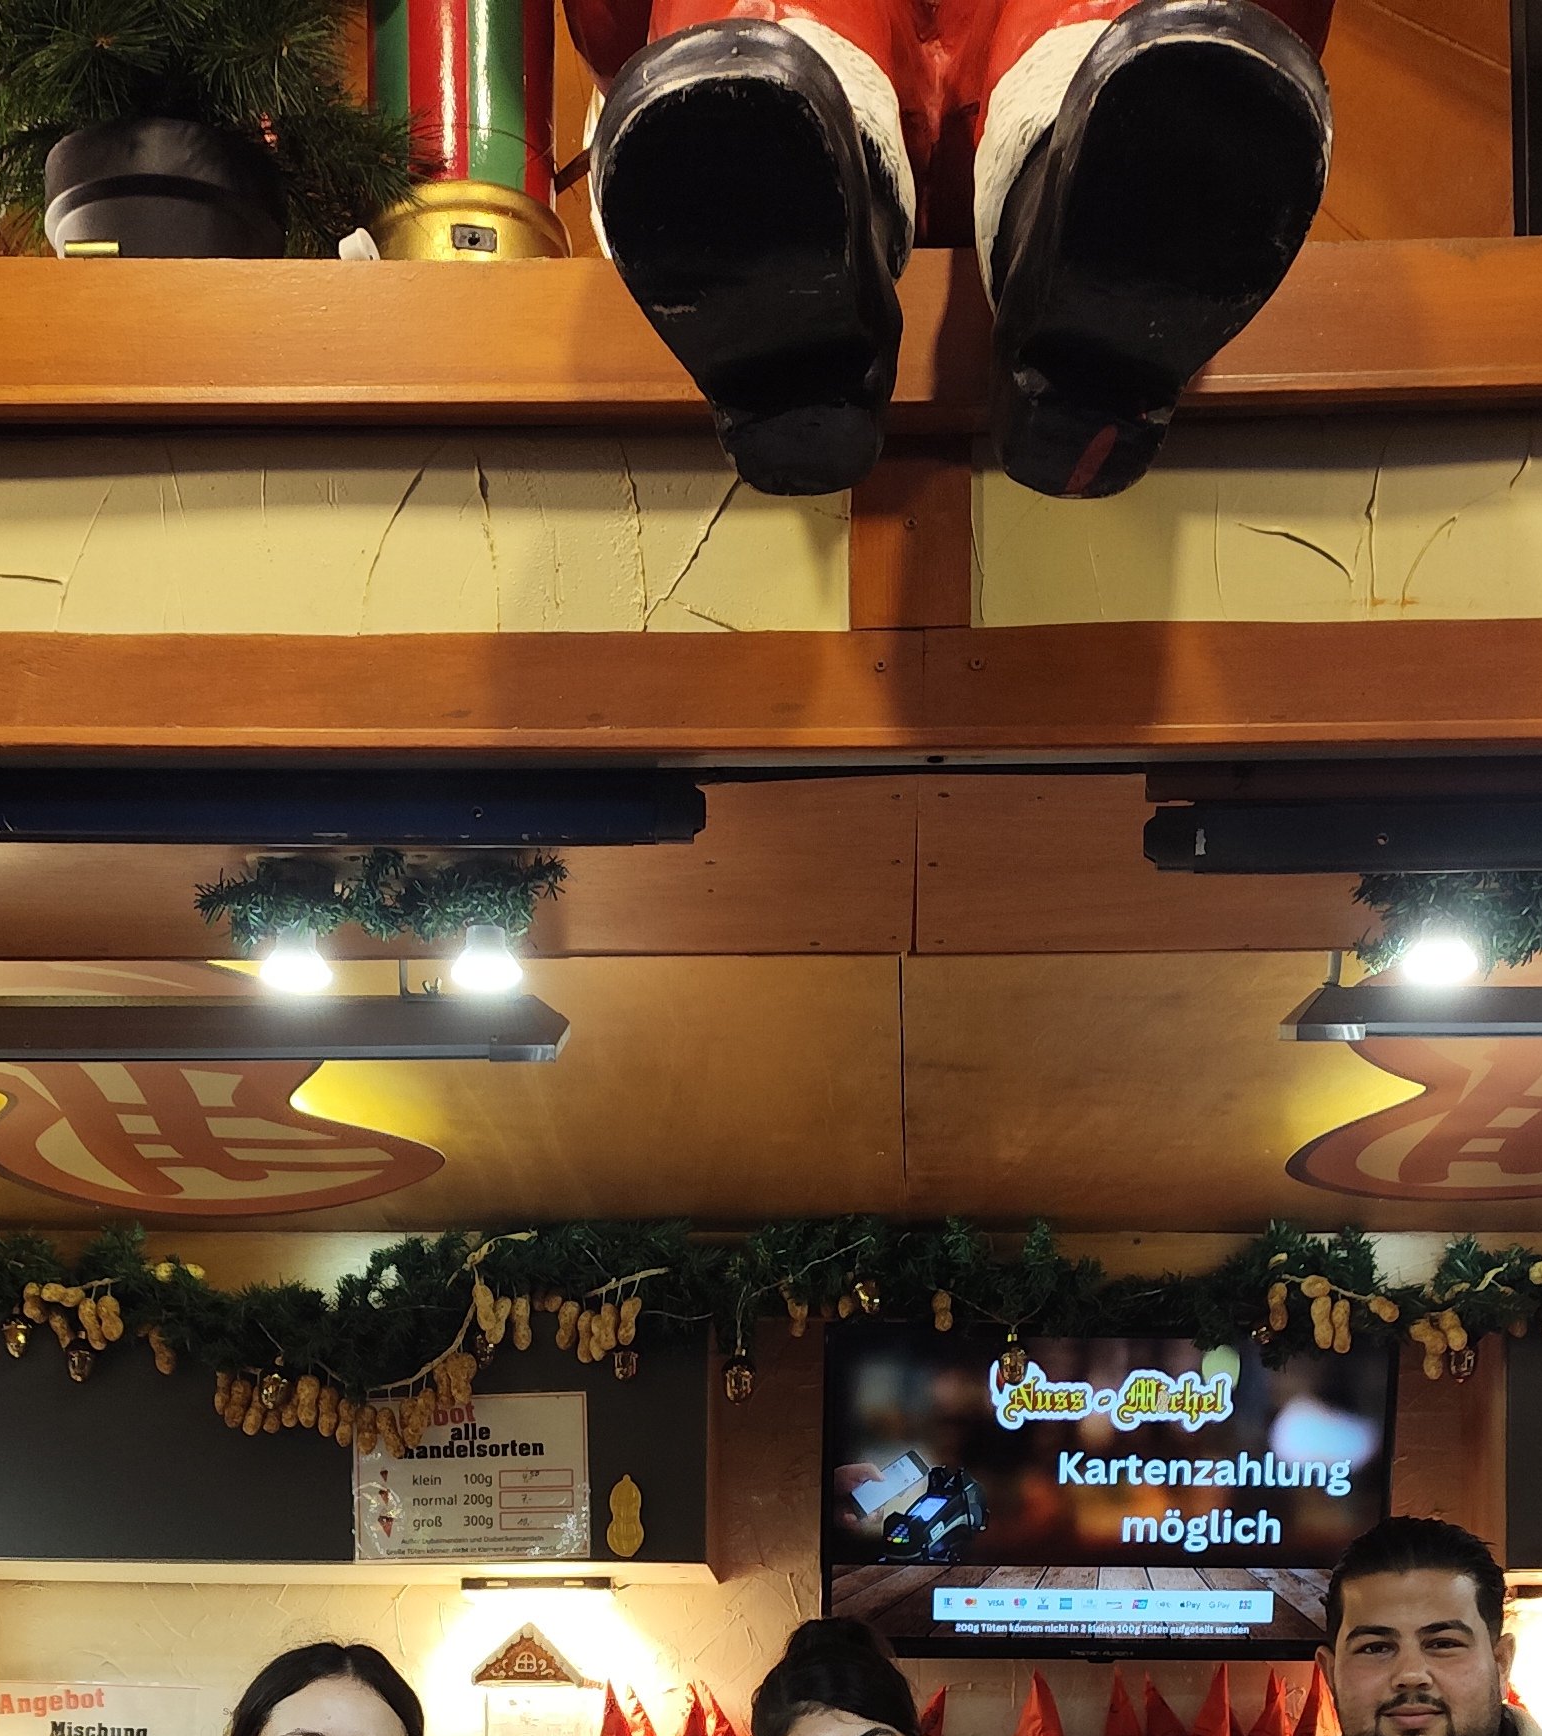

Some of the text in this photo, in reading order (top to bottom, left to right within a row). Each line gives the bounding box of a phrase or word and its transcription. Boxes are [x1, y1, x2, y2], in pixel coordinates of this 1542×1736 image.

[450, 1423, 490, 1440] alle
[412, 1475, 441, 1485] klein
[463, 1475, 492, 1487] 100g
[1057, 1452, 1351, 1495] Kartenzahlung
[412, 1495, 457, 1508] normal
[463, 1494, 493, 1507] 200g
[412, 1516, 442, 1531] groß
[463, 1516, 493, 1529] 300g
[1122, 1509, 1281, 1552] möglich
[955, 1623, 979, 1633] 200g
[1045, 1624, 1067, 1633] nicht
[1117, 1625, 1139, 1635] 100g
